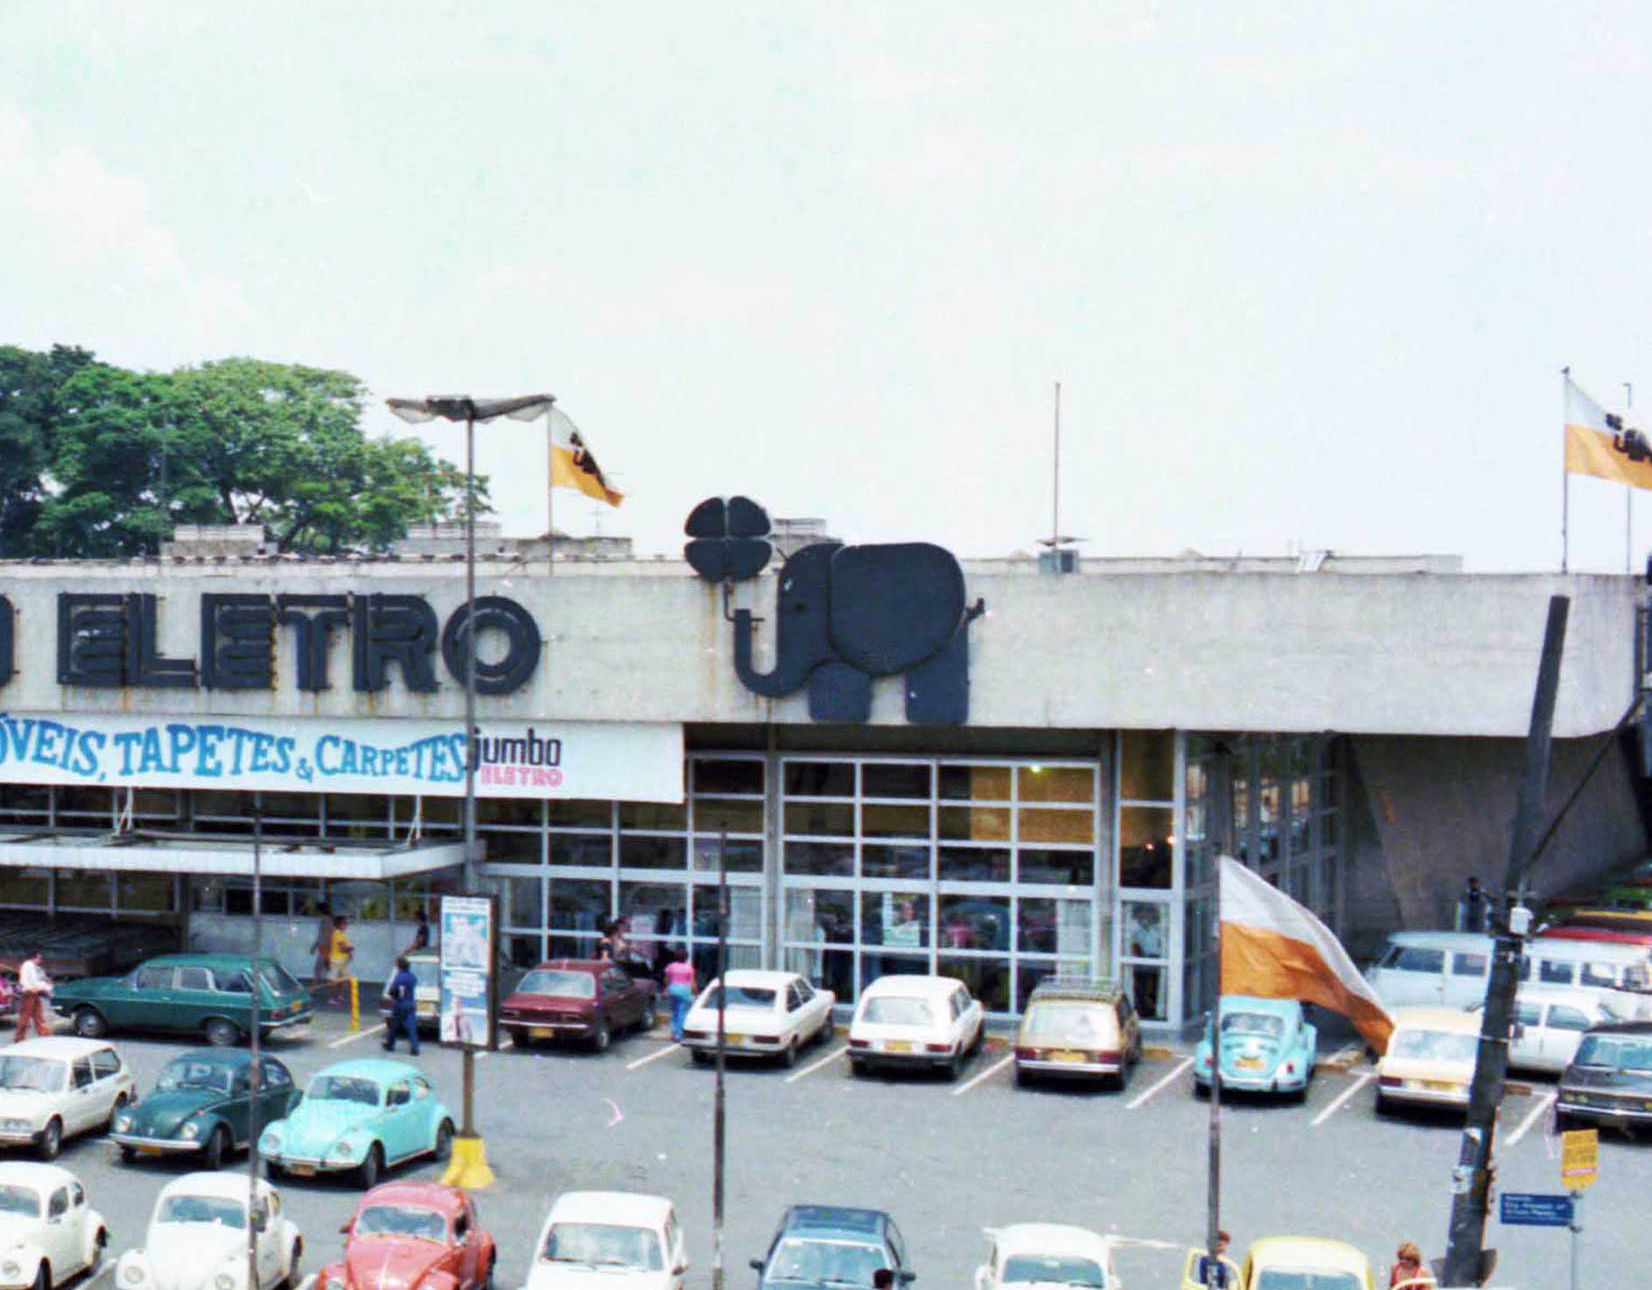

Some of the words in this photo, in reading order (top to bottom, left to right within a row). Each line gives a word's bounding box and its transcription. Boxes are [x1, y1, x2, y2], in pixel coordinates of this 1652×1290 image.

[57, 592, 542, 695] ELETRO
[114, 723, 296, 777] TAPETES
[296, 756, 313, 783] &
[315, 732, 470, 783] CARPETES
[463, 726, 562, 771] jumbo
[480, 765, 564, 787] ELETRO
